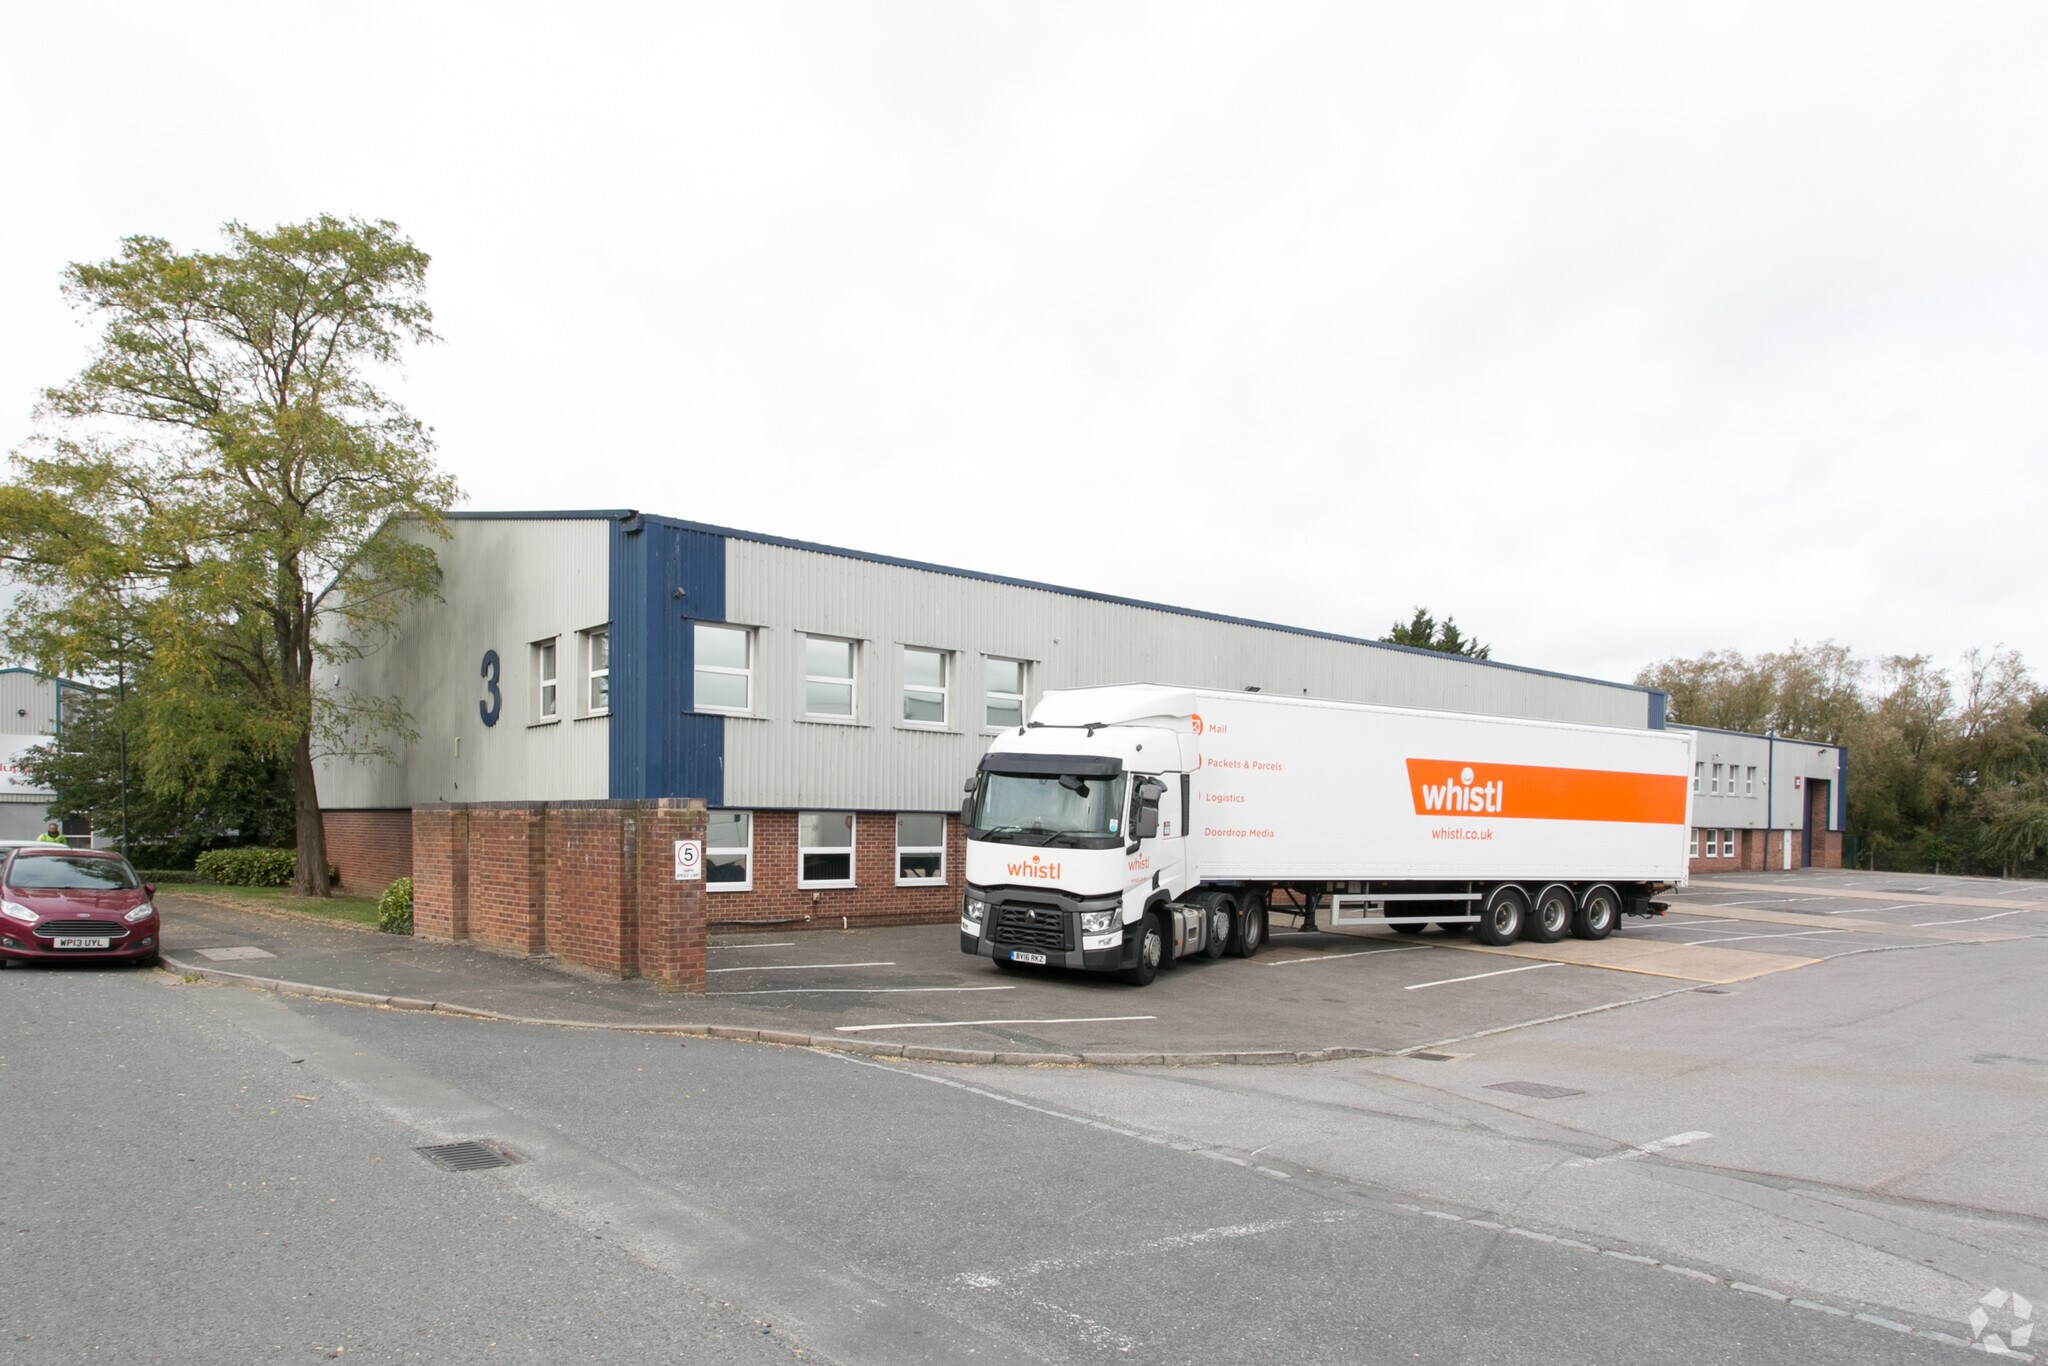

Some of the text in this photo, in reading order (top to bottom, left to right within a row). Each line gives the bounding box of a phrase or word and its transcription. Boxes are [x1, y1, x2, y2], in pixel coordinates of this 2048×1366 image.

[480, 649, 502, 727] 3
[1209, 724, 1228, 734] Mail
[1207, 758, 1283, 771] Packets & Parcels
[1422, 767, 1504, 813] whistl
[1206, 793, 1246, 804] Logistics
[1204, 827, 1275, 839] Doordrop Media
[1431, 827, 1493, 840] whistl.co.uk
[684, 848, 693, 861] 5
[1007, 855, 1061, 880] whistl
[1128, 853, 1150, 871] whistl
[60, 939, 103, 947] WP13 UYL
